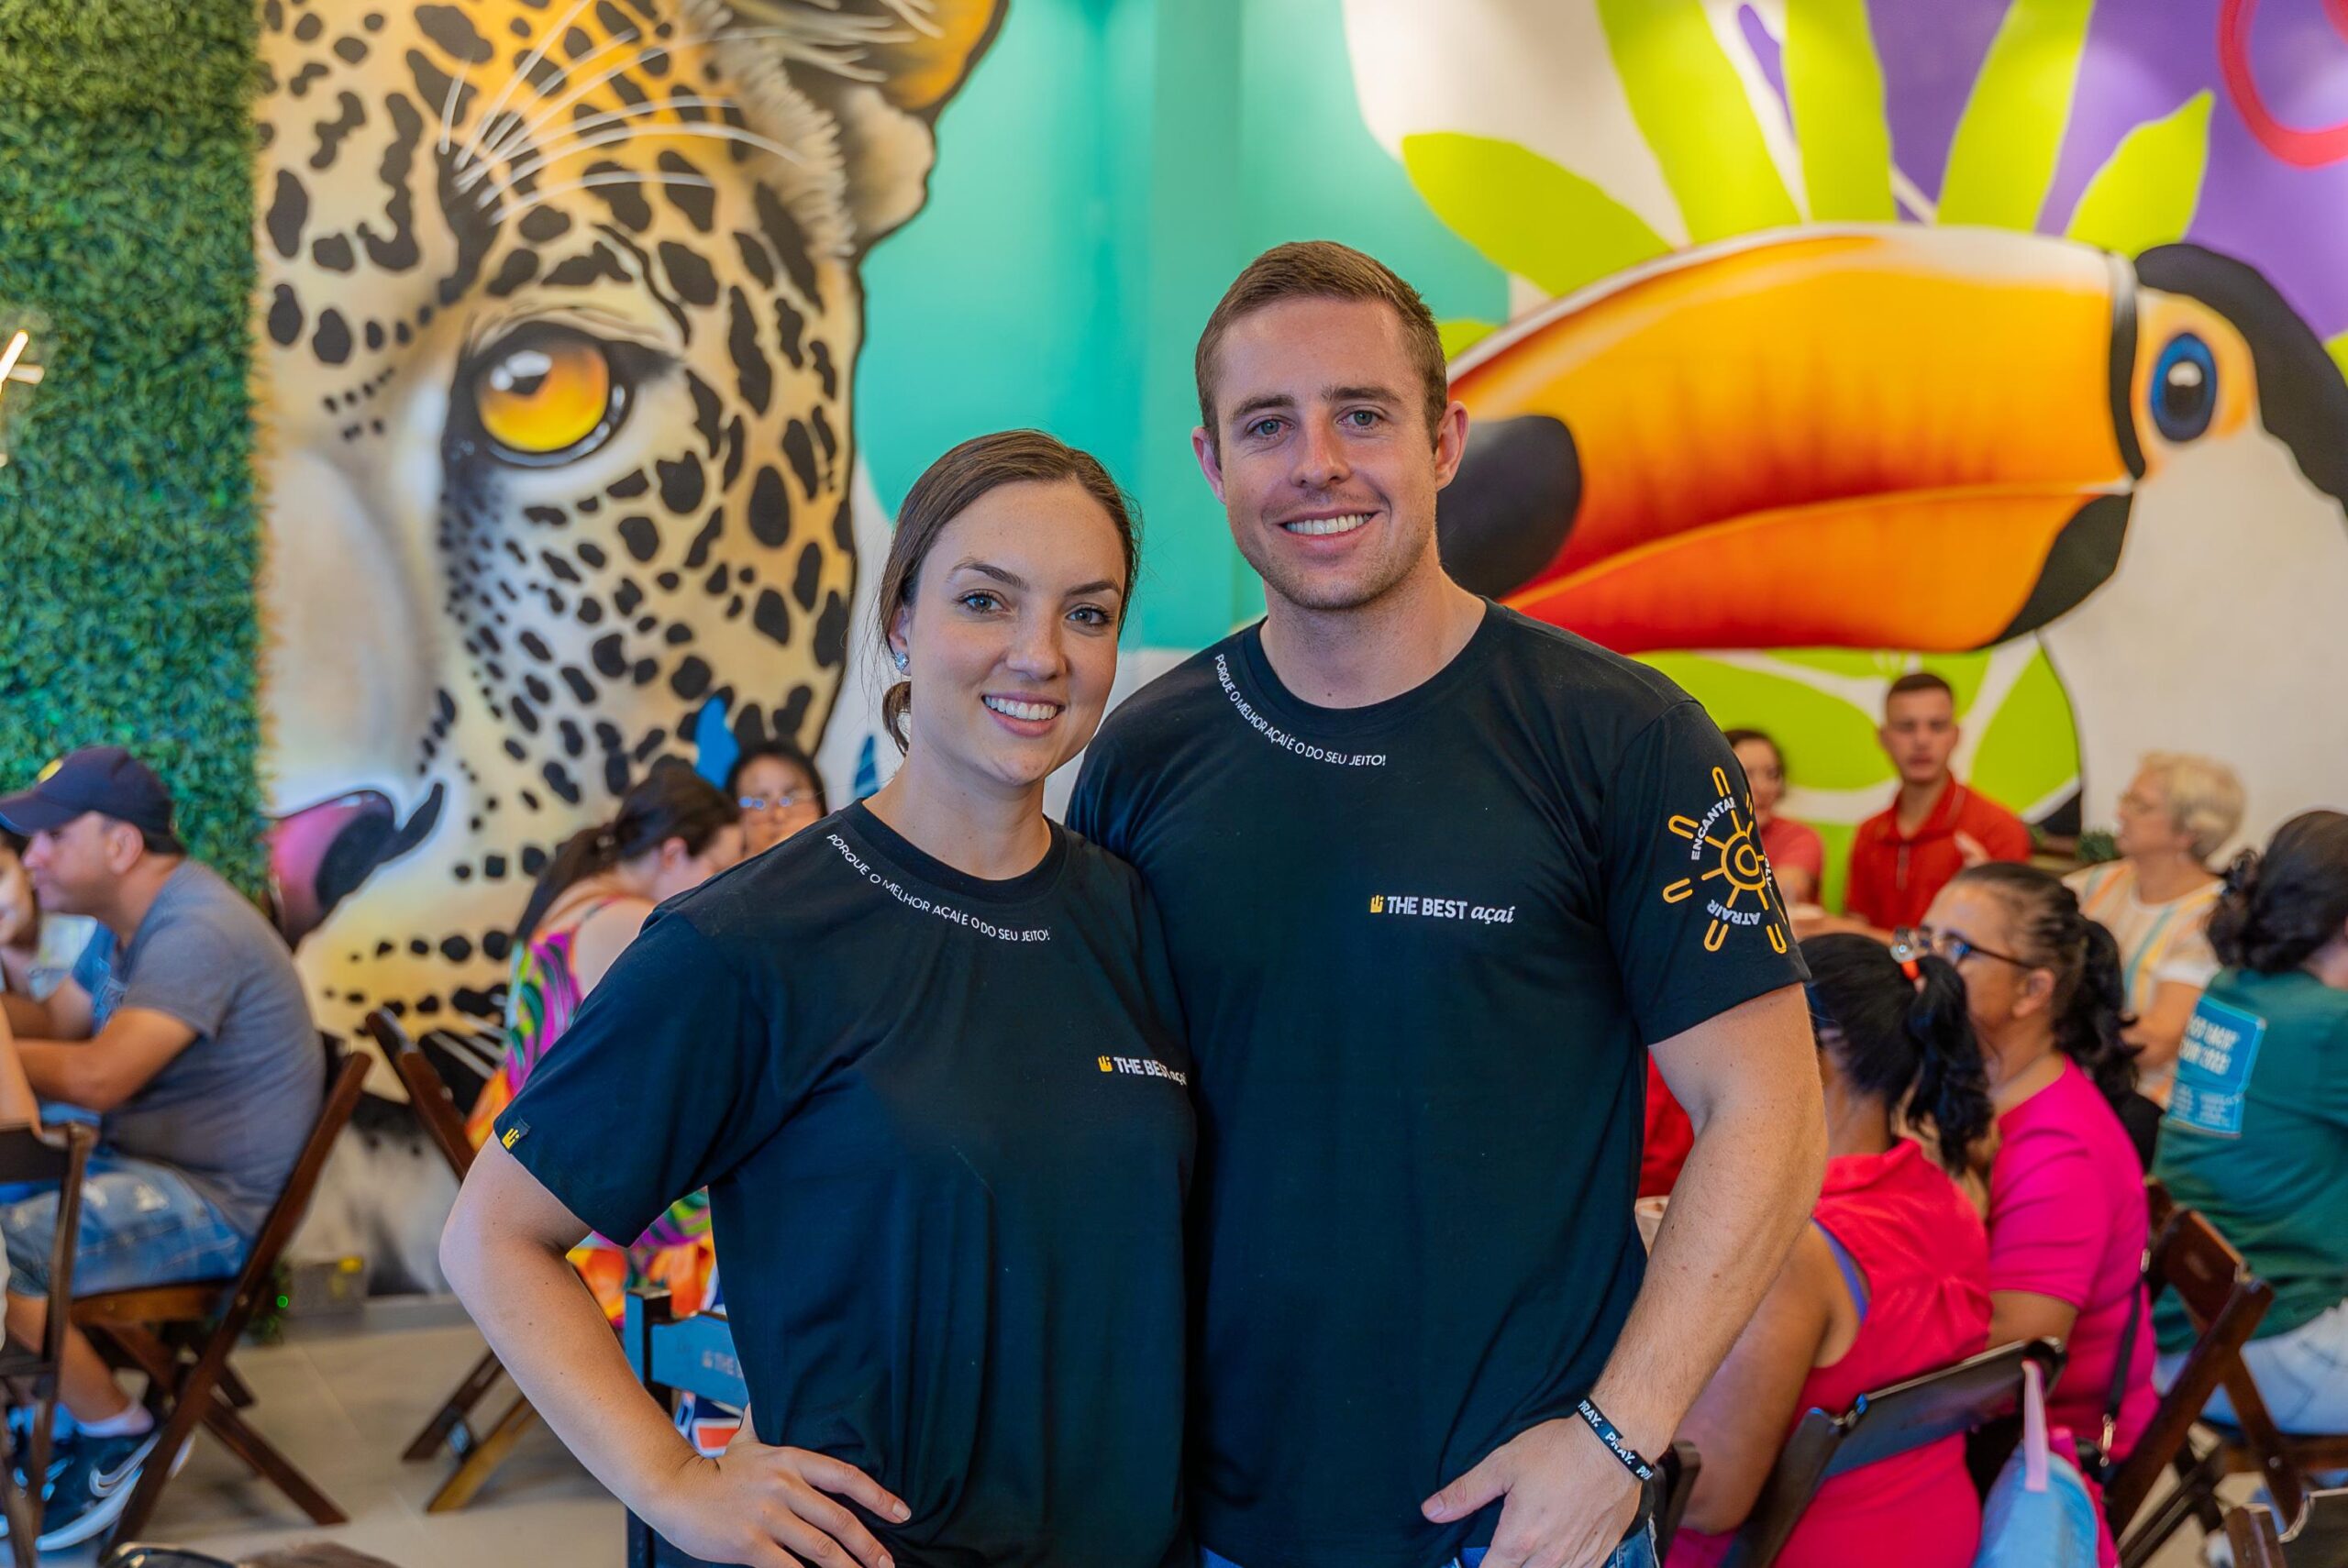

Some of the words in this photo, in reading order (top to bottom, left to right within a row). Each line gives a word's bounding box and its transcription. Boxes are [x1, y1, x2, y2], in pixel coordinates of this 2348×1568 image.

[1214, 653, 1236, 694] PORQUE
[1229, 690, 1241, 702] O
[1235, 698, 1268, 733] MELHOR
[1264, 726, 1291, 746] AÇAÍ
[1294, 742, 1305, 755] O
[1305, 745, 1324, 760] DO
[1324, 751, 1346, 766] SEU
[1348, 755, 1387, 767] JEITO!
[826, 834, 870, 876] PORQUE
[869, 873, 881, 884] O
[882, 878, 931, 912] MELHOR
[932, 904, 962, 923] AÇAÍ
[970, 917, 980, 929] O
[980, 922, 996, 937] DO
[998, 928, 1018, 941] SEU
[1021, 929, 1050, 942] JEITO!
[1387, 896, 1419, 915] THE
[1422, 898, 1468, 920] BEST
[1470, 906, 1516, 925] açaí
[1706, 899, 1761, 925] ATRAIR
[1113, 1056, 1145, 1075] THE
